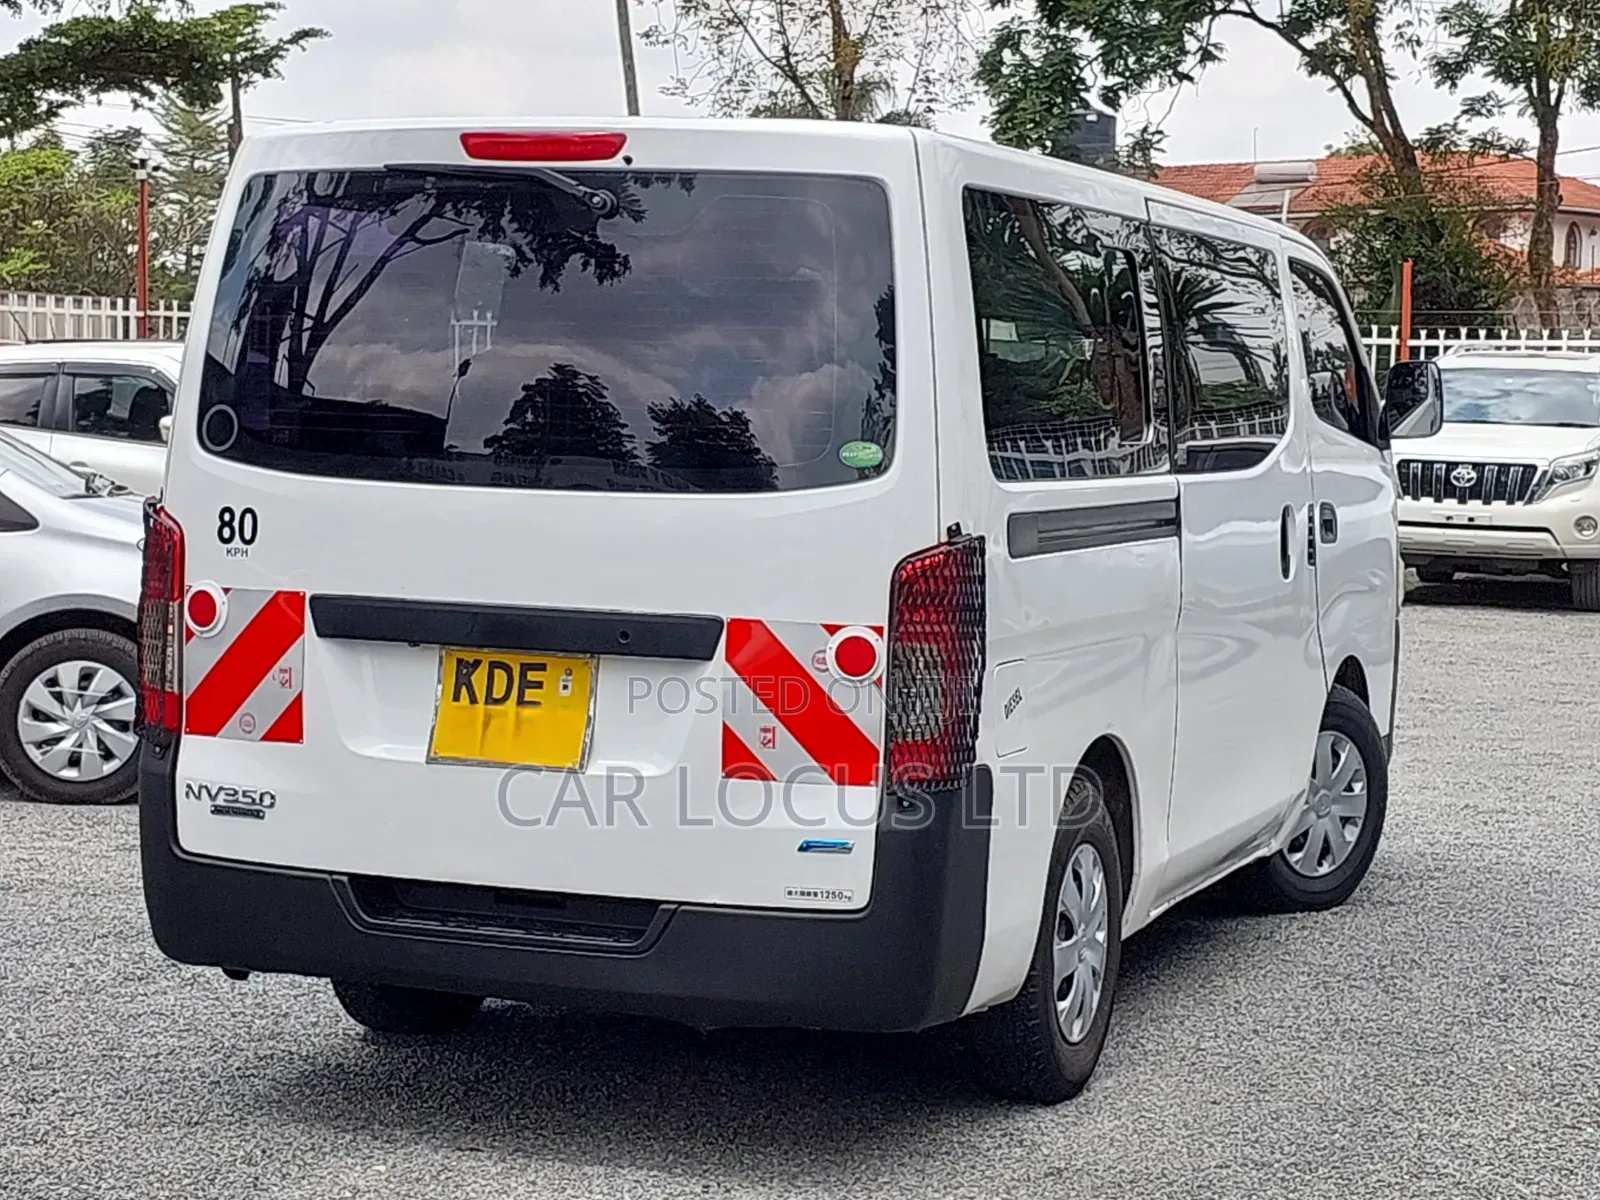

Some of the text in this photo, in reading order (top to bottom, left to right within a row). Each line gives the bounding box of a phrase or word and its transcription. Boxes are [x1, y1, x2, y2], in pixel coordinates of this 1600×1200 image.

[217, 506, 259, 547] 80
[226, 547, 249, 558] KPH
[452, 657, 548, 706] KDE
[1004, 686, 1023, 720] DIESEL
[185, 781, 276, 809] NV350
